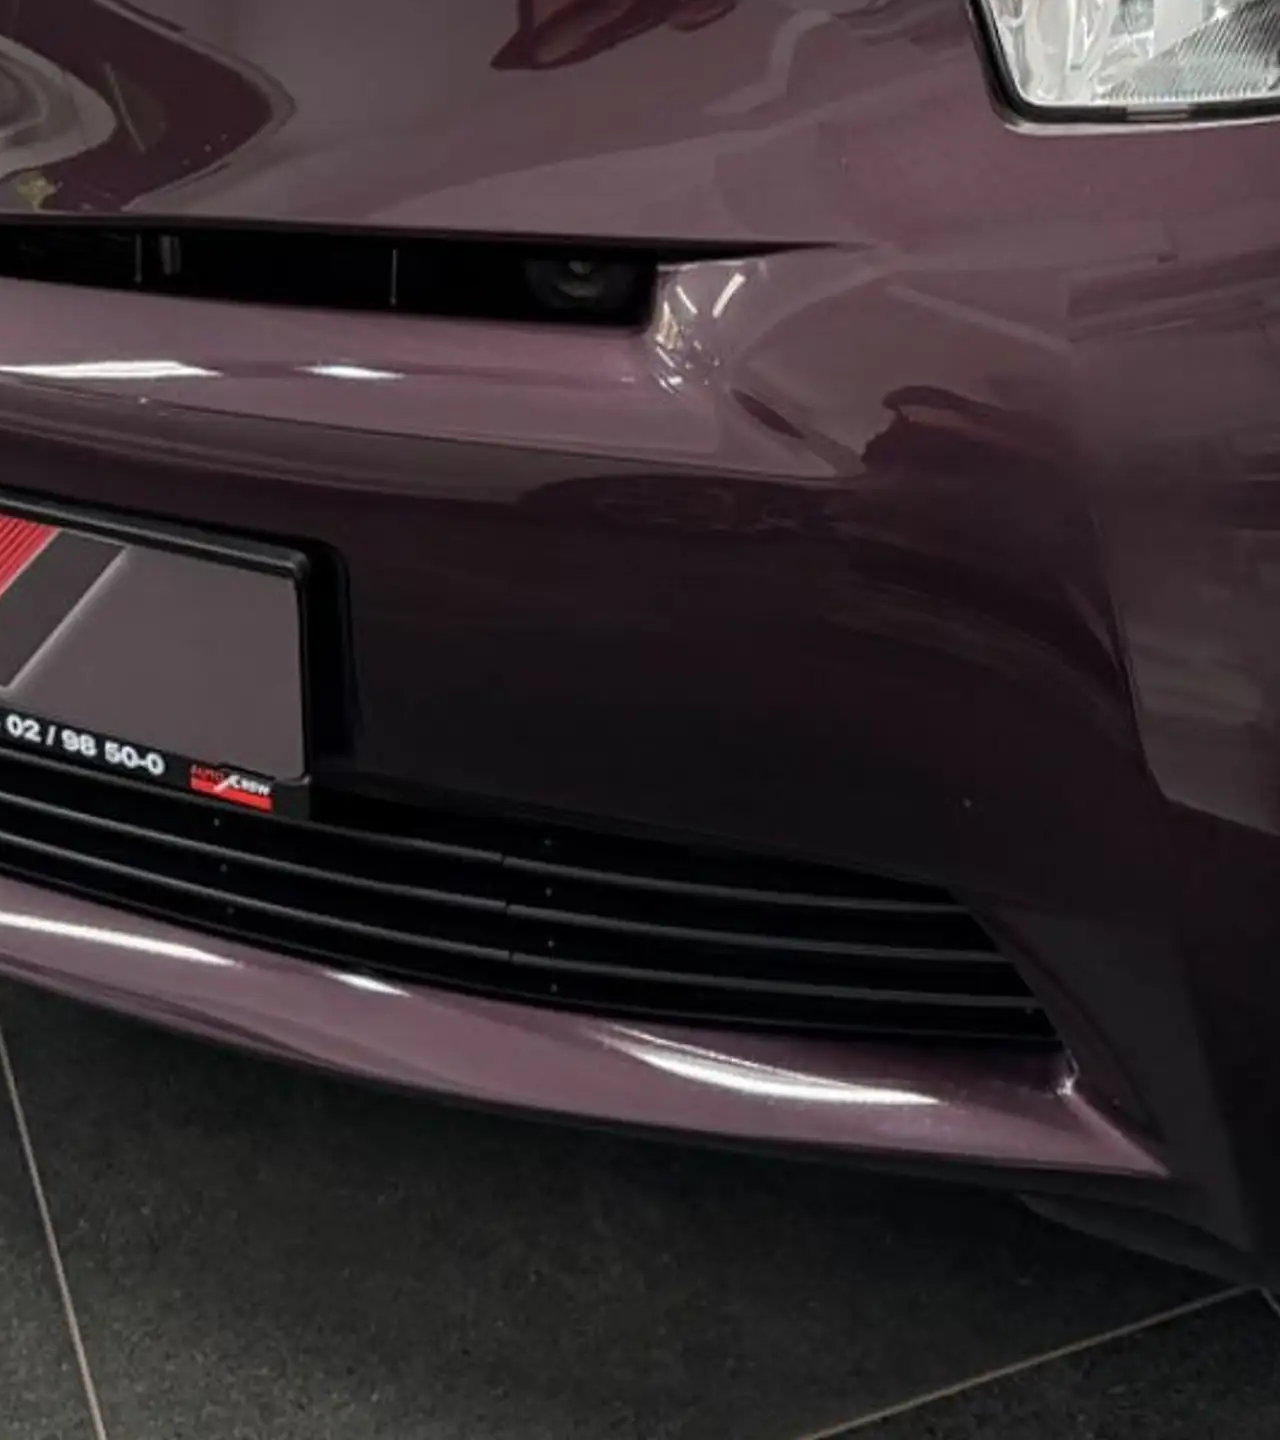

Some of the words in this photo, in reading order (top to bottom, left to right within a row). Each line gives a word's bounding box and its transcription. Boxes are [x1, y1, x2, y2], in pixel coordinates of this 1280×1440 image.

[5, 713, 43, 743] 02
[60, 728, 98, 758] 98
[104, 740, 166, 776] 50-0
